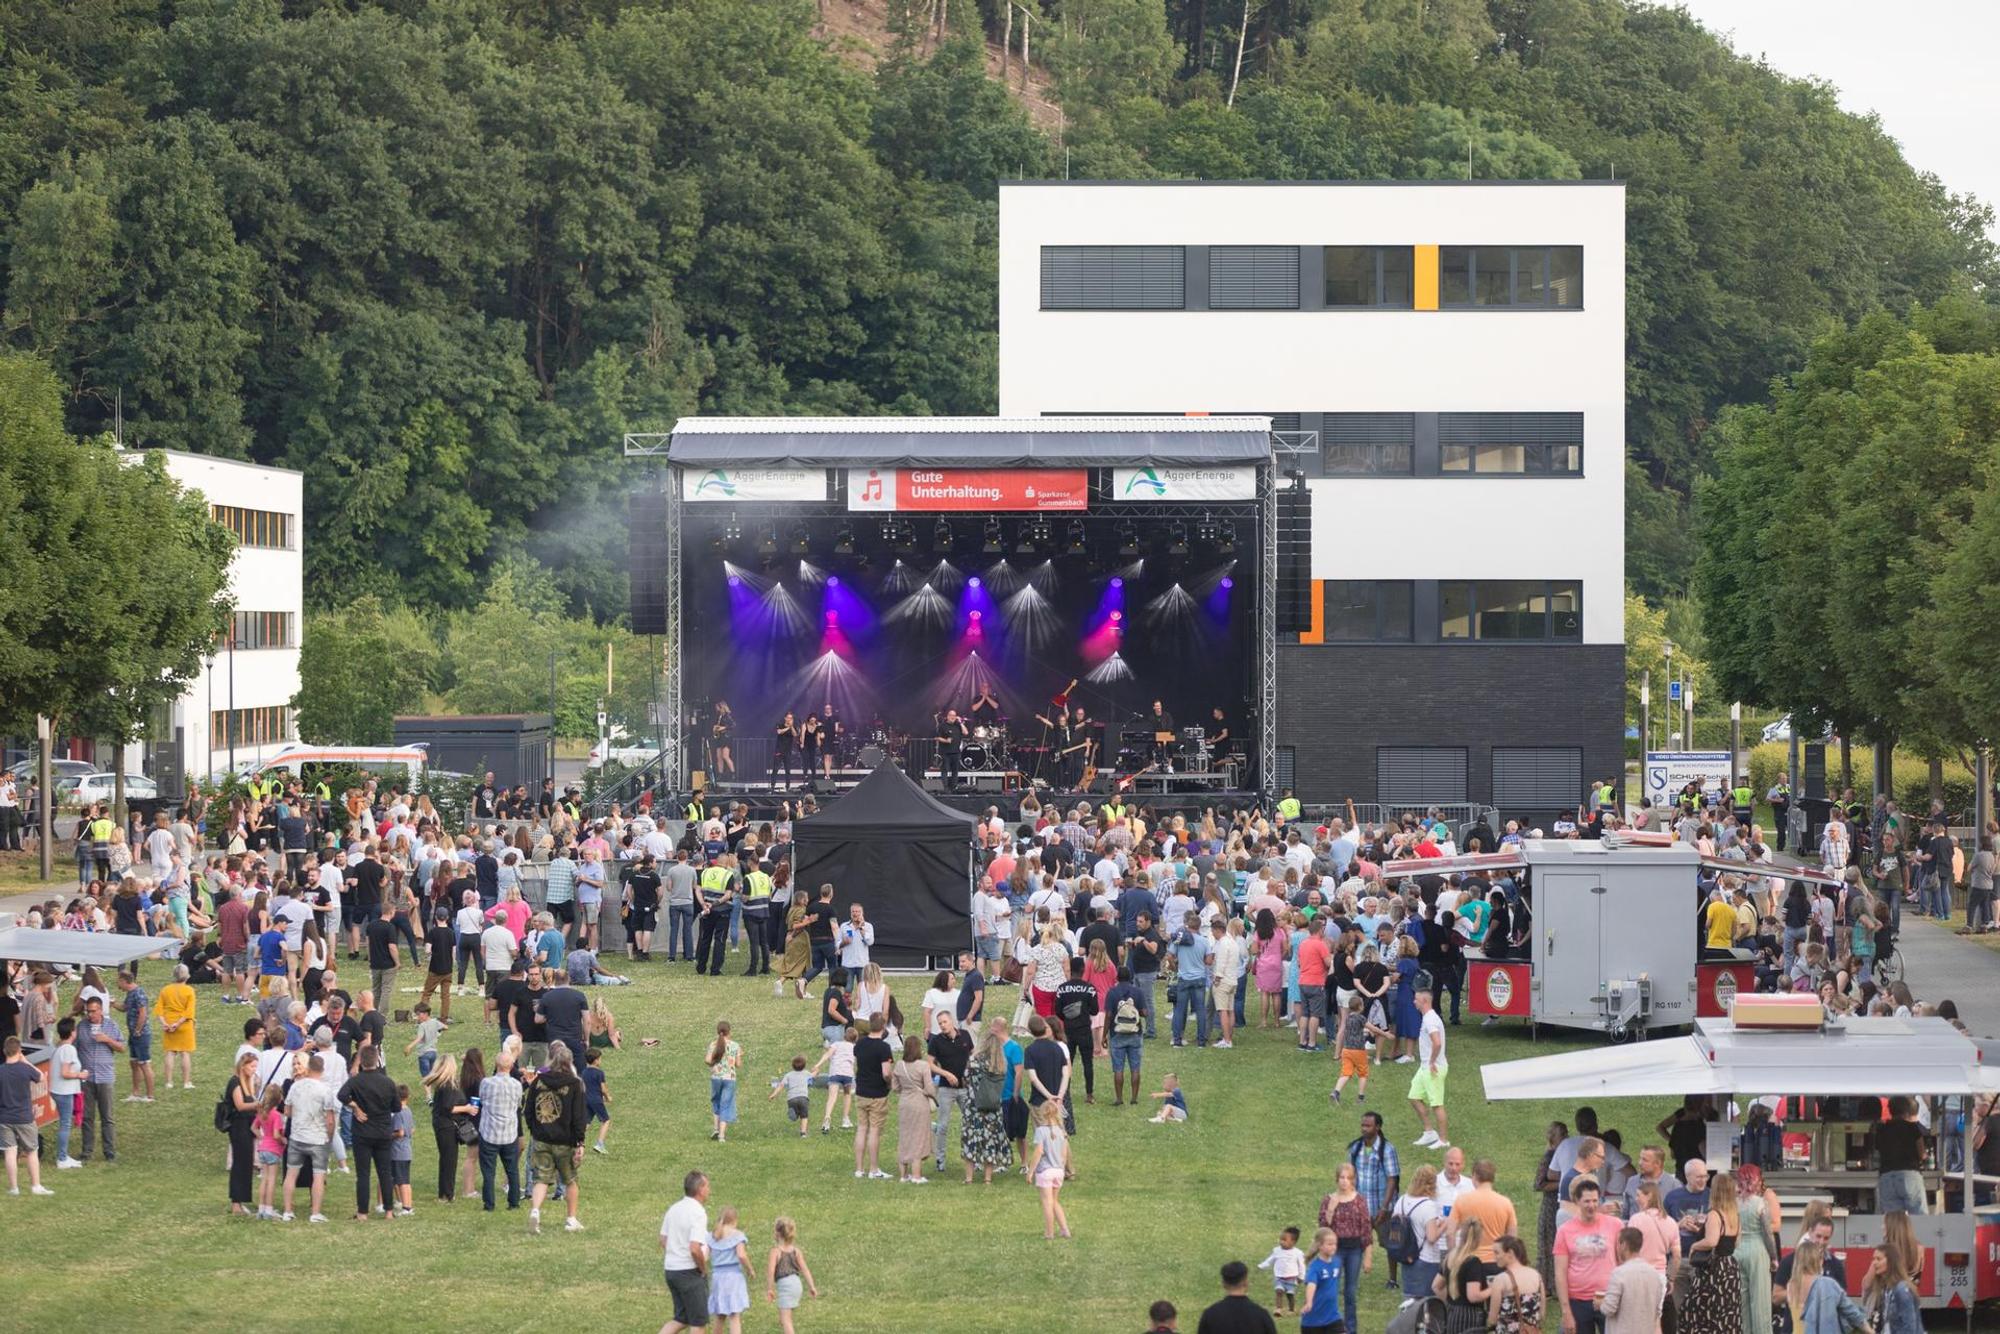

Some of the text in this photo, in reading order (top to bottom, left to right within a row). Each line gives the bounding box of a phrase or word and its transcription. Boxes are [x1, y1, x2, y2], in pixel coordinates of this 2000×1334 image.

[733, 471, 805, 482] AggerEnergie
[911, 471, 944, 484] Gute
[1163, 470, 1236, 481] AggerEnergie
[911, 485, 1003, 500] Unterhaltung.
[1667, 1001, 1681, 1009] 1107
[1951, 1266, 1966, 1276] BB
[1951, 1276, 1968, 1287] 255
